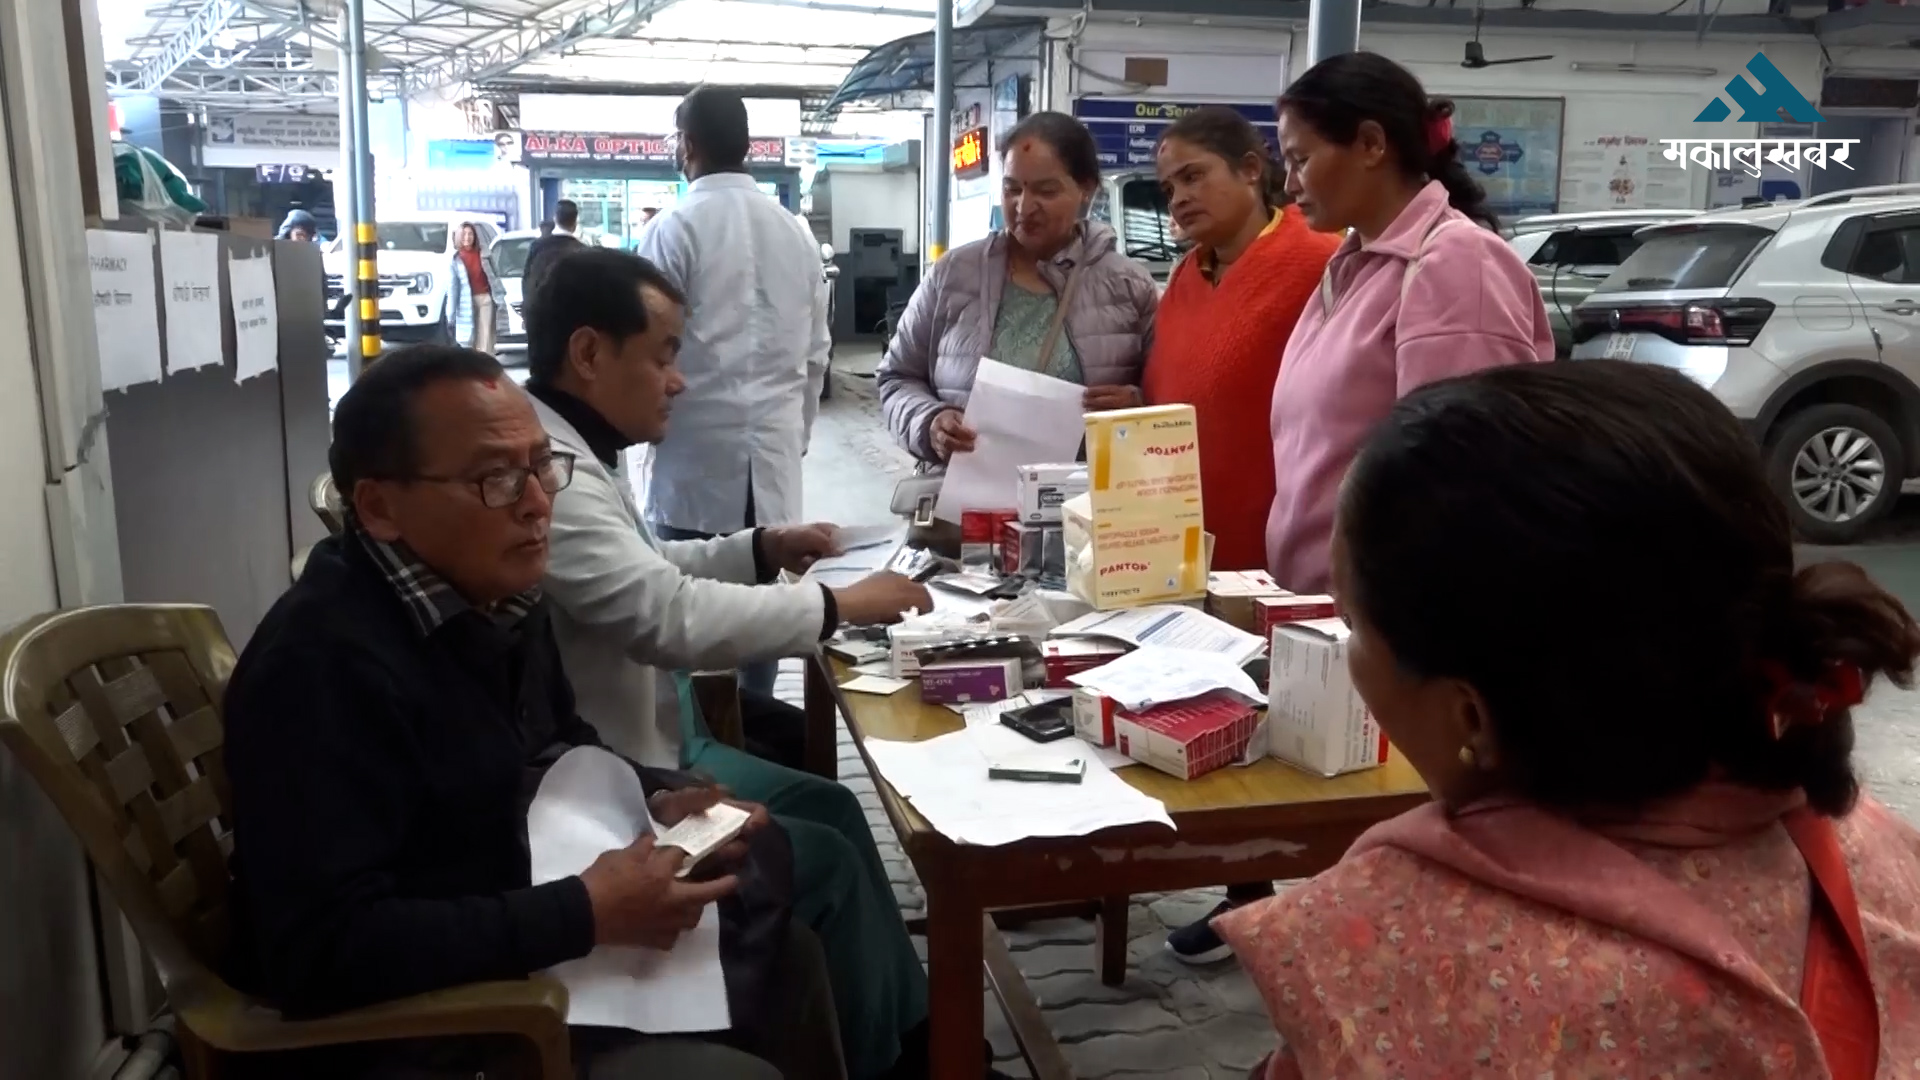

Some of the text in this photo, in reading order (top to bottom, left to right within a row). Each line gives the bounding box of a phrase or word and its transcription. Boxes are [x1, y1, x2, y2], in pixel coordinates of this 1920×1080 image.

[1135, 103, 1197, 117] Our Serv
[524, 134, 588, 153] ALKA
[1100, 563, 1148, 577] PANTOP
